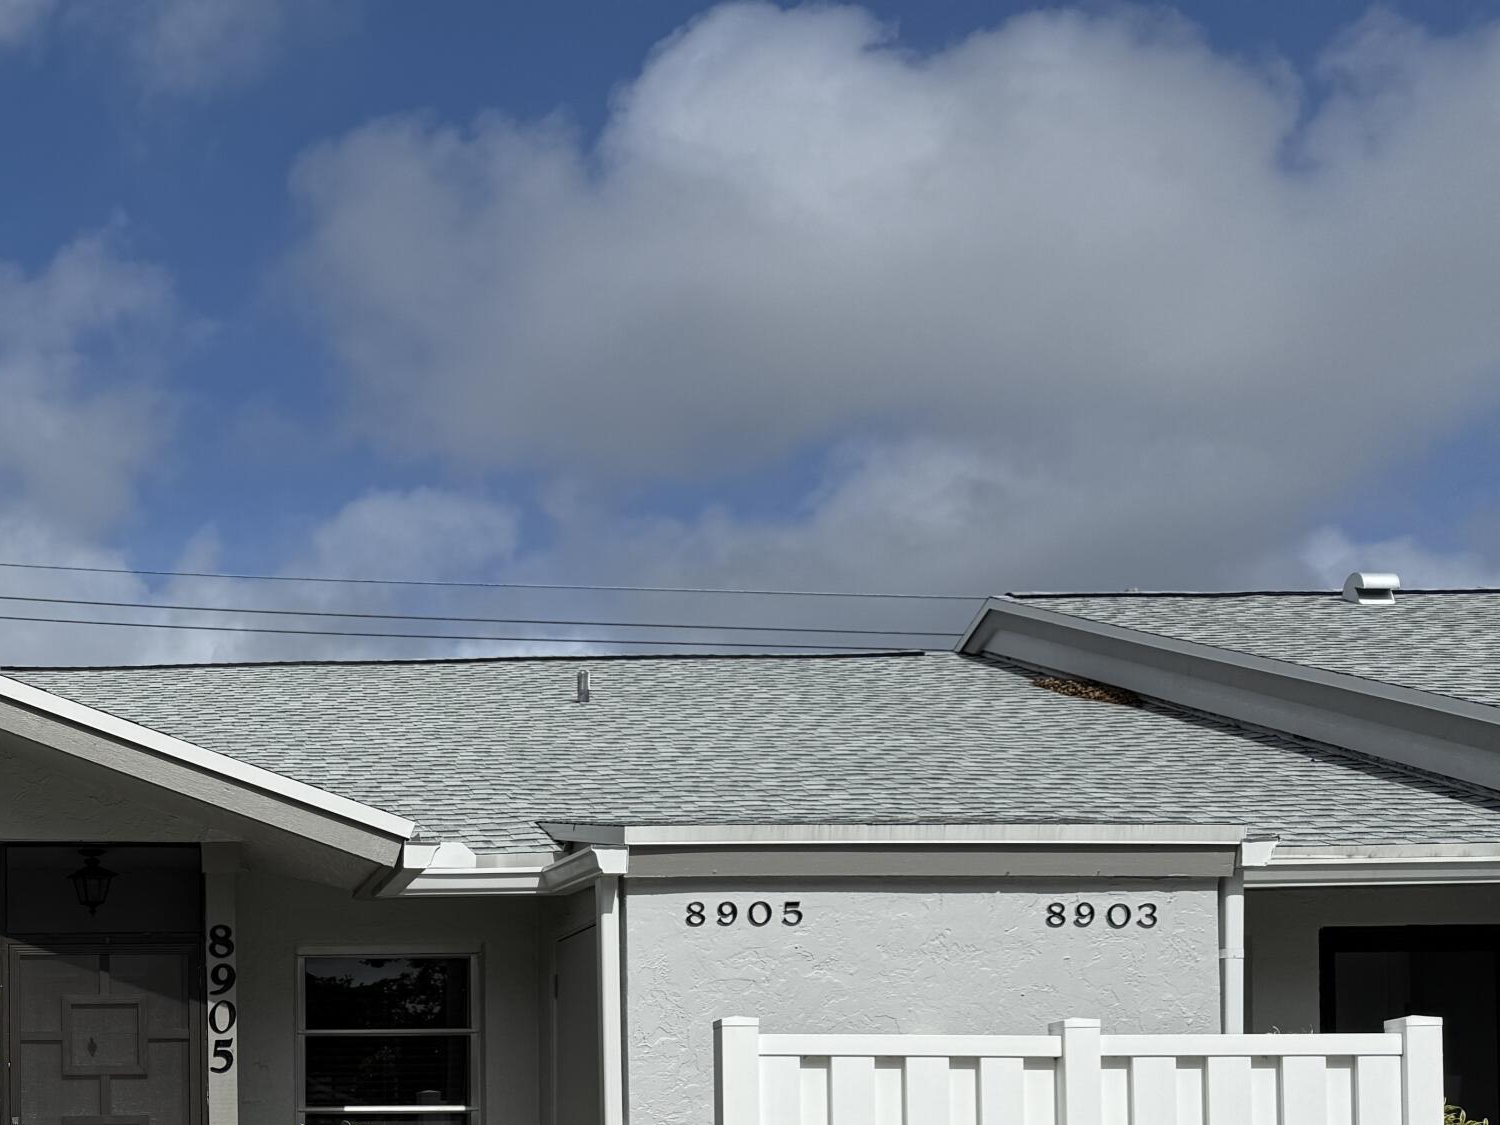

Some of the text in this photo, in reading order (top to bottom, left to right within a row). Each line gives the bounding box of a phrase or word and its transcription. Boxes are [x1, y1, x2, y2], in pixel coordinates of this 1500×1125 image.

[685, 900, 804, 928] 8905
[1045, 901, 1159, 930] 8903
[208, 924, 237, 1074] 8905
